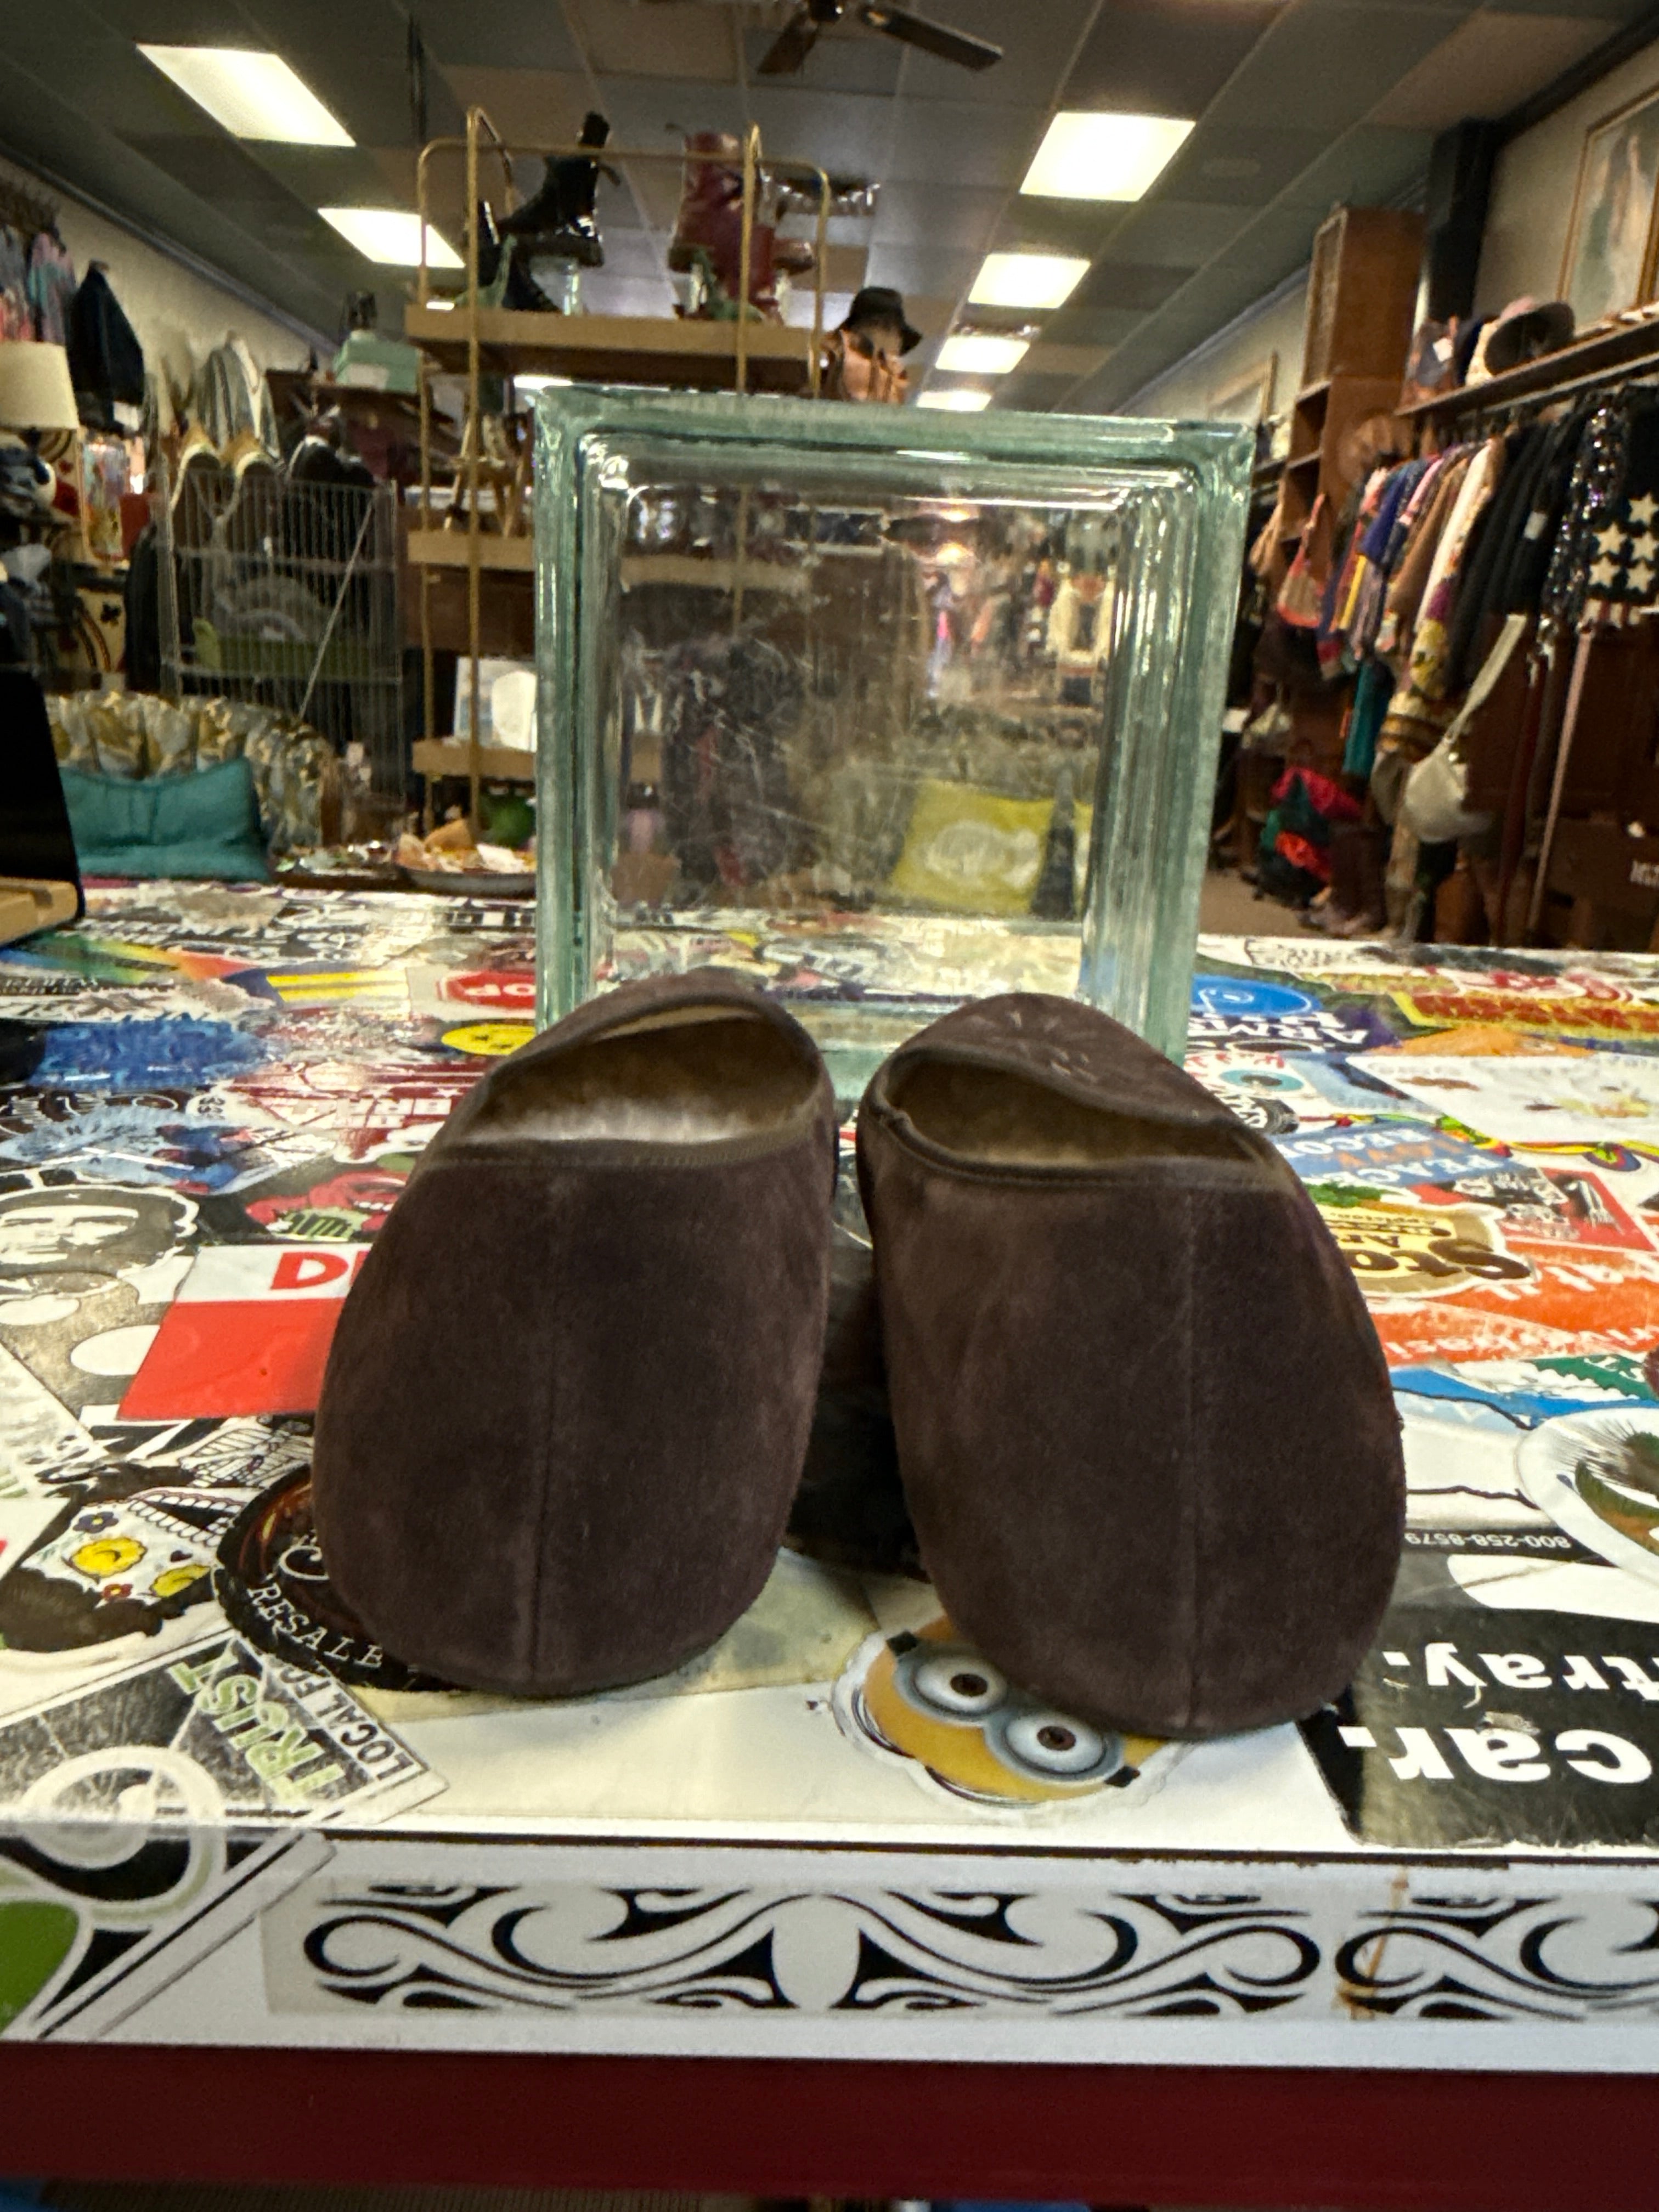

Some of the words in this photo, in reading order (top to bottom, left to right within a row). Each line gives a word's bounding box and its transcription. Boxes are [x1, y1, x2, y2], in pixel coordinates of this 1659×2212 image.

[464, 983, 537, 996] OP
[1341, 1239, 1531, 1280] Sto
[1406, 1531, 1572, 1550] 800-258-8579
[247, 1583, 383, 1668] RESALE
[1383, 1642, 1659, 1702] tray.
[321, 1689, 415, 1782] LOCAL
[1338, 1725, 1652, 1784] car.
